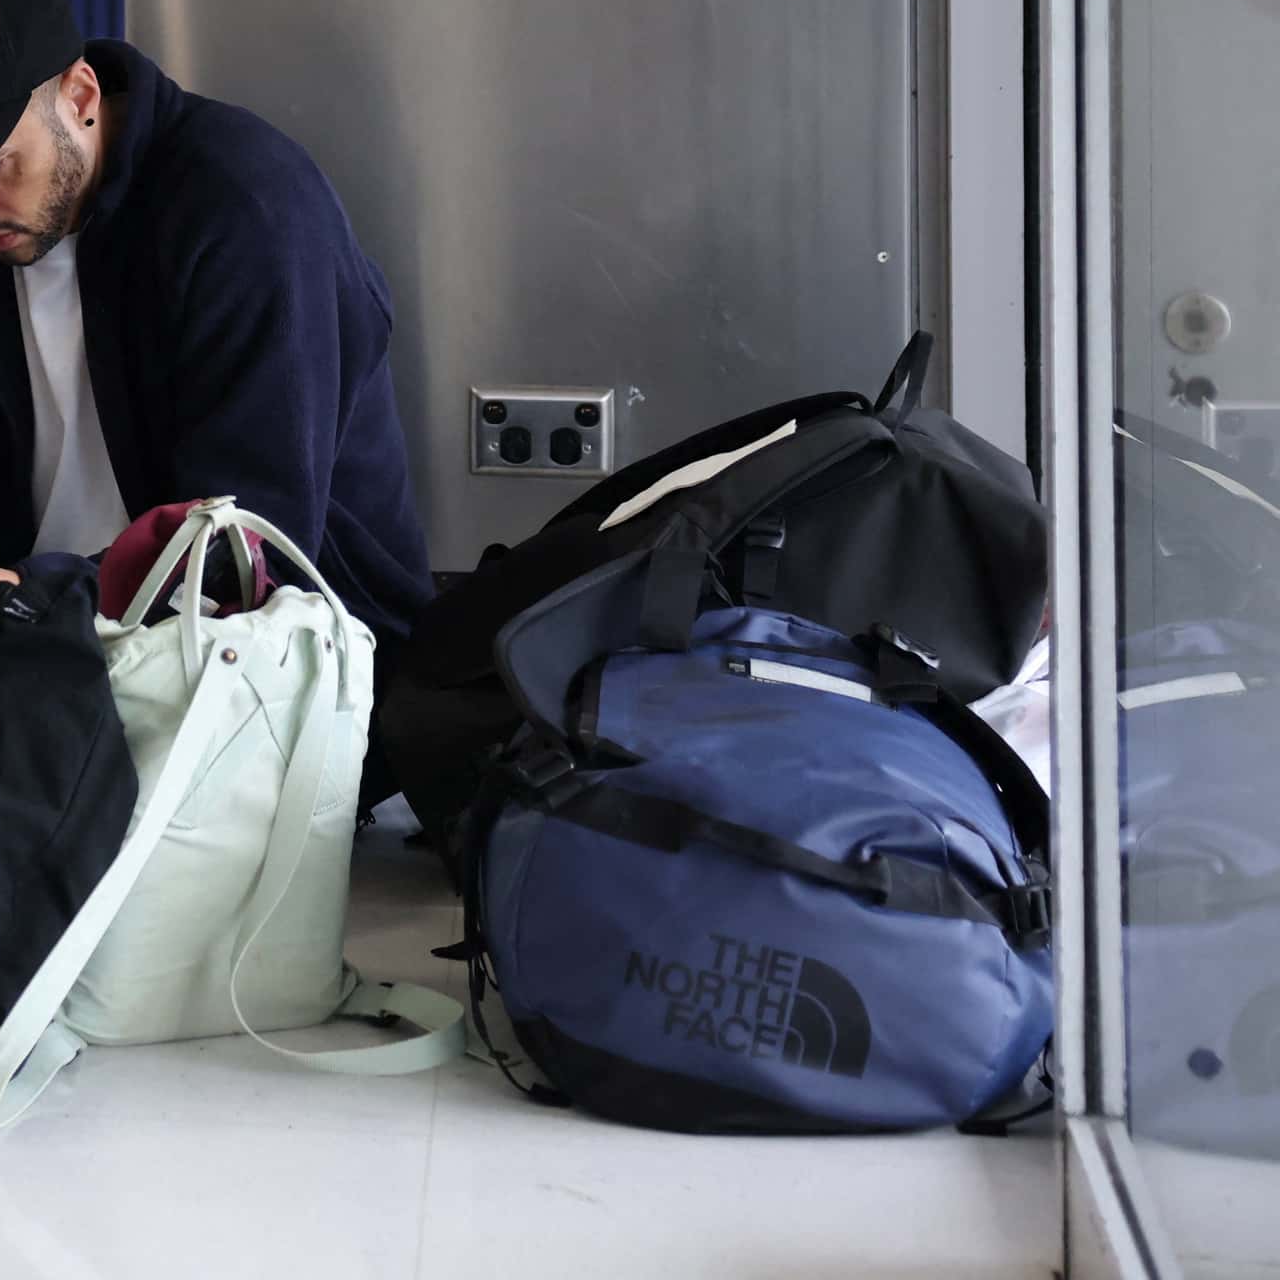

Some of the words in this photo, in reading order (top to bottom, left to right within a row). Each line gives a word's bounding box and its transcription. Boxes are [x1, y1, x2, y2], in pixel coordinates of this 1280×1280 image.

[623, 951, 790, 1025] NORTH
[709, 932, 799, 992] THE
[662, 1000, 786, 1059] FACE
